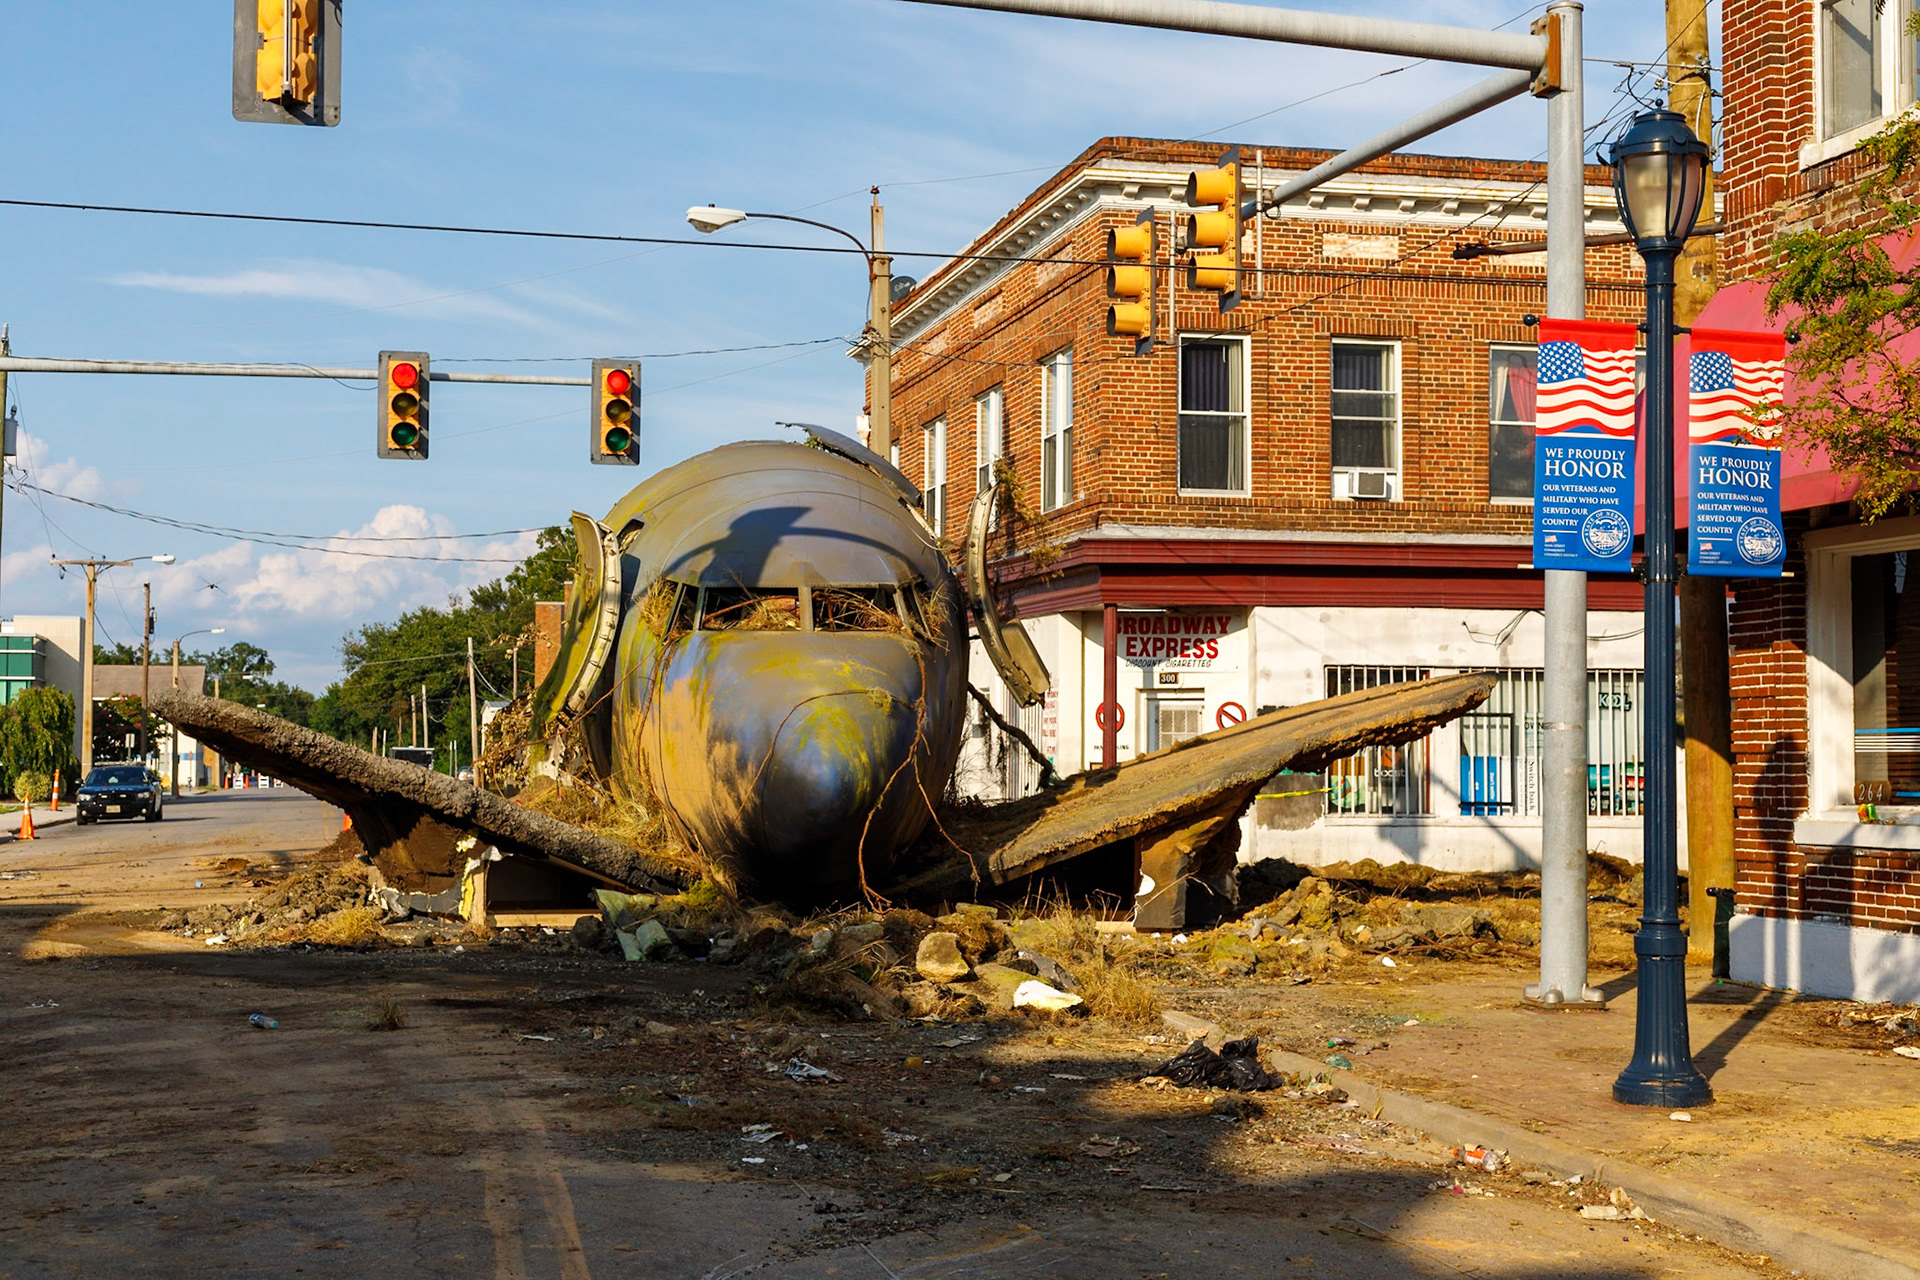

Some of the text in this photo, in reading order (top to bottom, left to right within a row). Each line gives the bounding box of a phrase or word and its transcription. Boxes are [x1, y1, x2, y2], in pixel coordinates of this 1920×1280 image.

[1545, 447, 1625, 460] WE PROUDLY
[1699, 456, 1772, 471] WE PROUDLY
[1545, 460, 1626, 479] HONOR
[1699, 467, 1773, 490] HONOR
[1543, 484, 1560, 492] OUR
[1561, 485, 1598, 493] VETERANS
[1600, 497, 1619, 505] HAVE
[1715, 493, 1749, 501] VETERANS
[1750, 495, 1764, 503] AND
[1542, 507, 1570, 515] SERVED
[1733, 505, 1751, 513] WHO
[1752, 506, 1768, 514] HAVE
[1542, 518, 1578, 526] COUNTRY
[1584, 515, 1594, 536] STATE
[1606, 511, 1628, 538] NEBRASKA
[1726, 515, 1743, 523] OUR
[1697, 526, 1733, 534] COUNTRY
[1739, 523, 1749, 544] STATE
[1126, 636, 1219, 659] EXPRESS
[1125, 659, 1212, 668] DISCOUNT CIGARETTES
[1599, 693, 1632, 710] KOOL
[1859, 783, 1883, 801] 264
